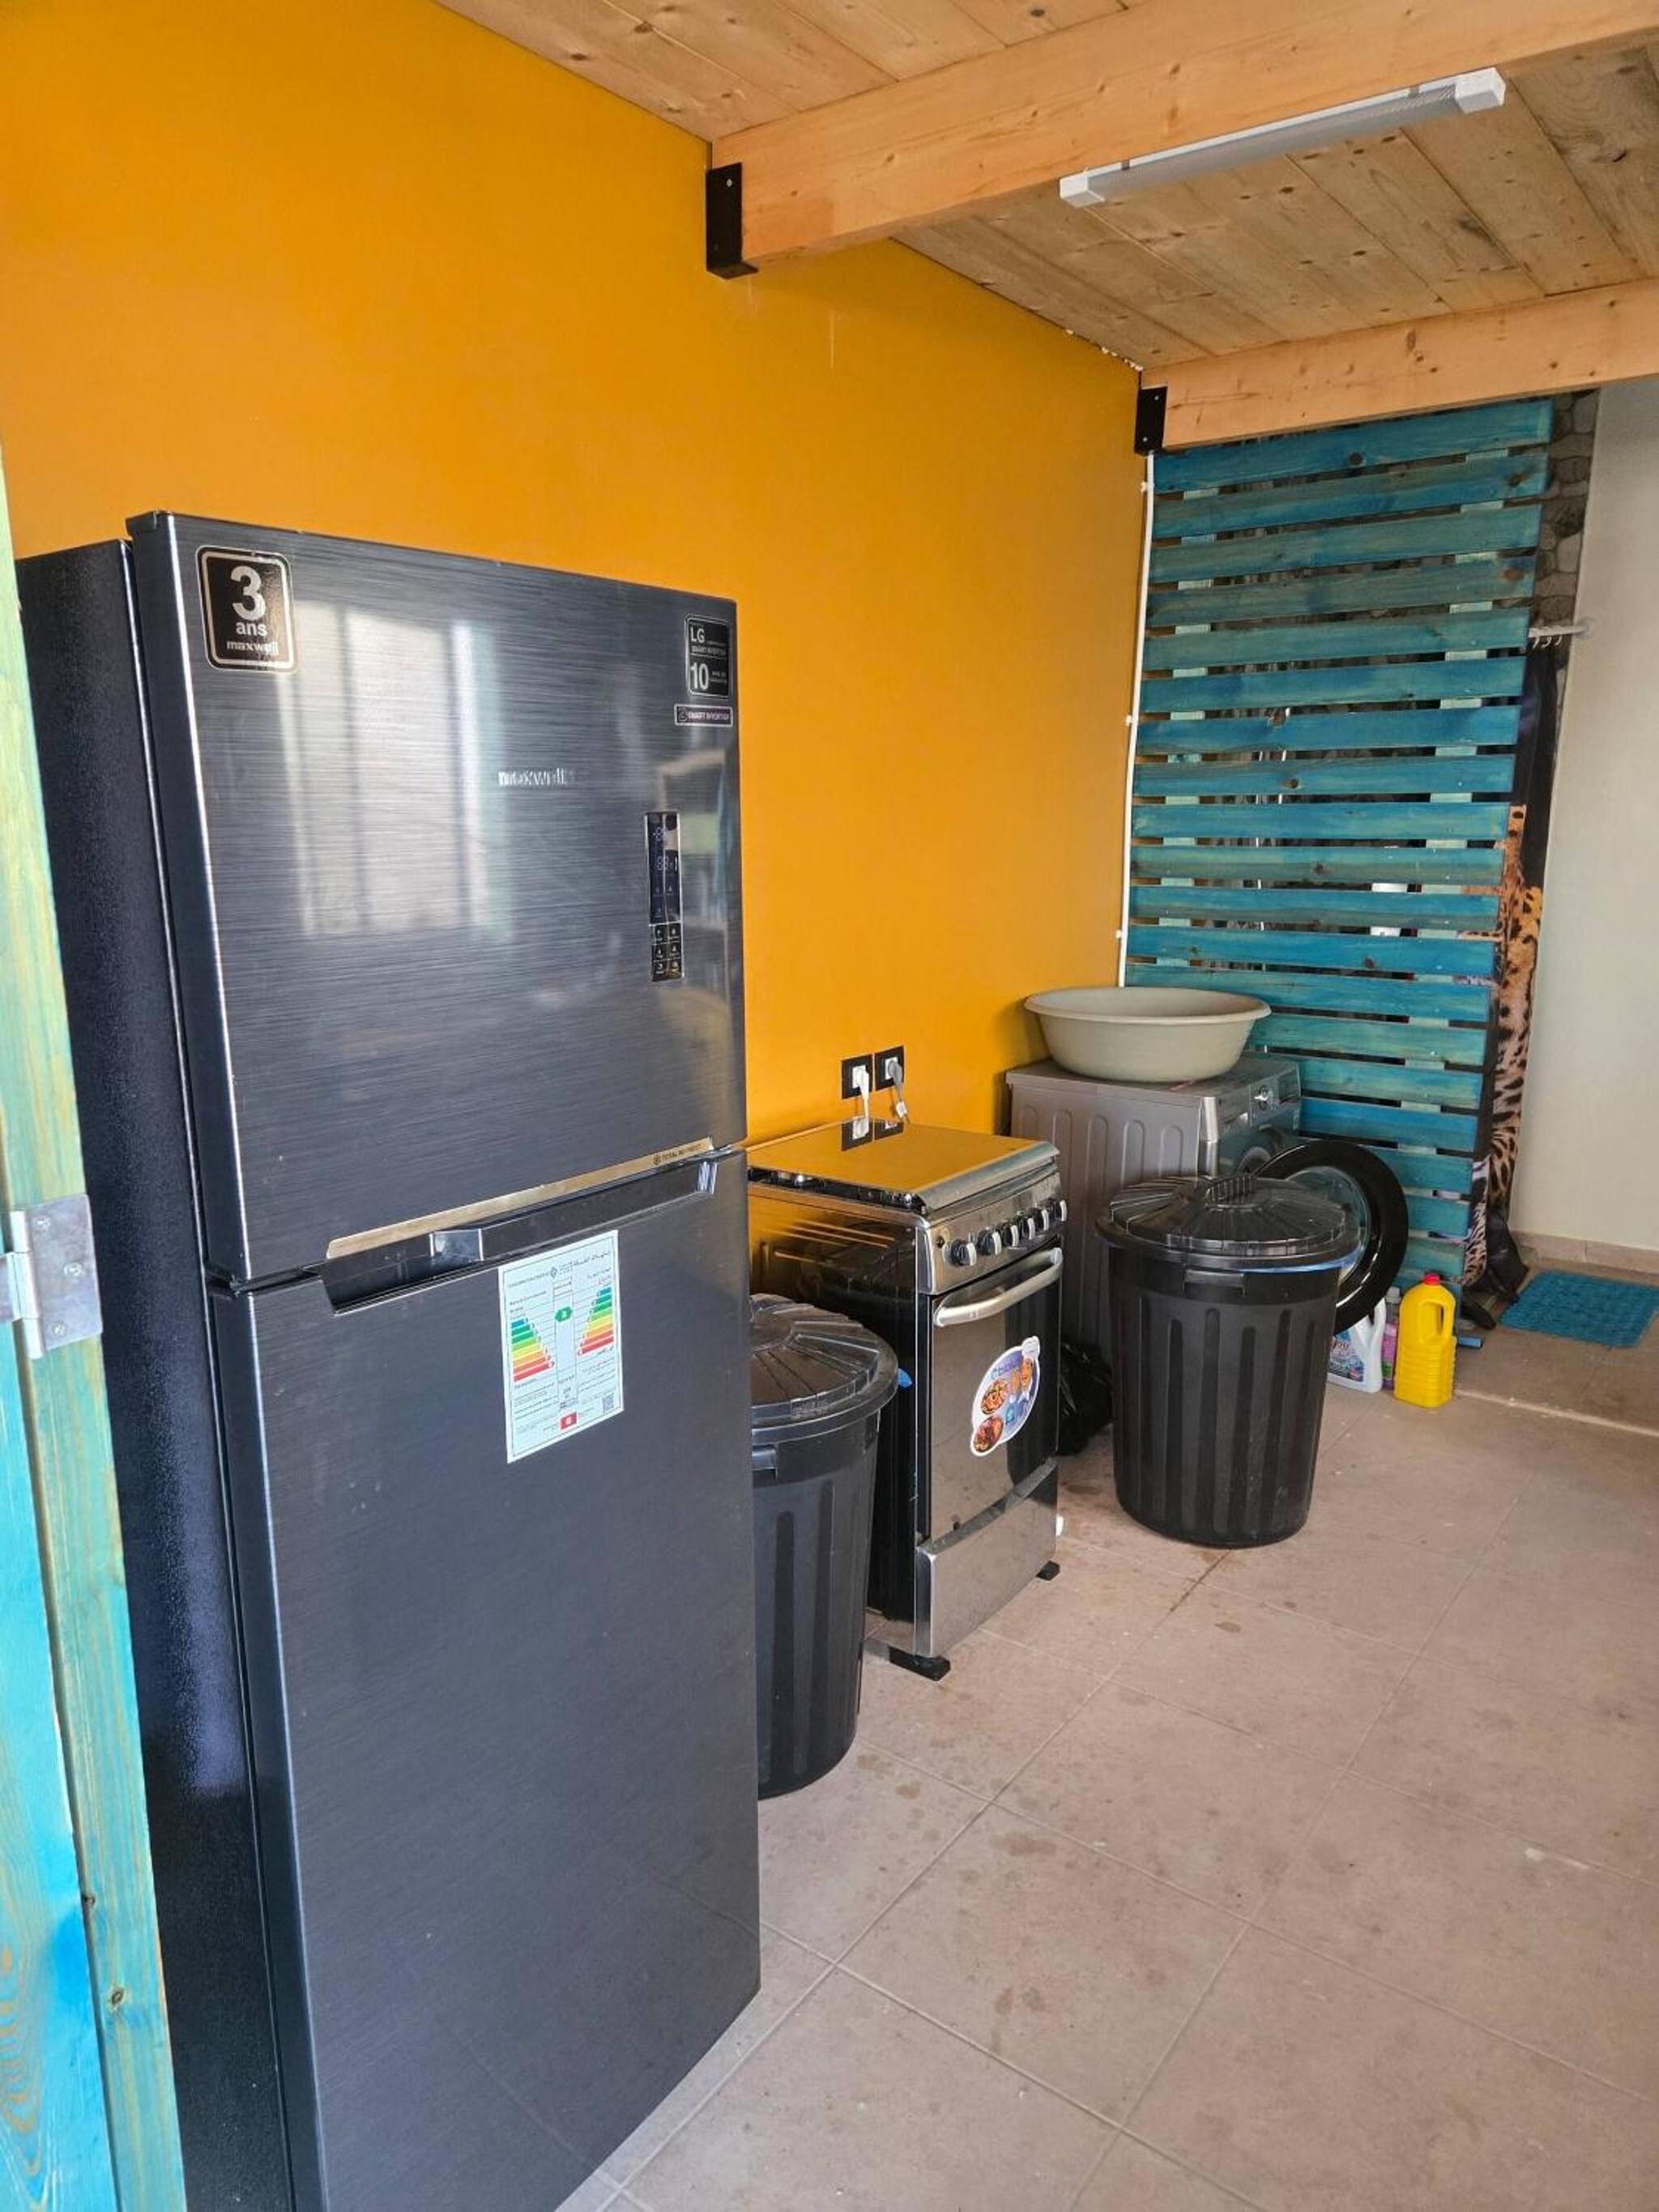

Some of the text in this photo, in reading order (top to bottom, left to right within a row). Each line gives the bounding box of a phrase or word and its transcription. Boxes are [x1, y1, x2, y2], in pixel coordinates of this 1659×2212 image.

[230, 565, 266, 620] 3
[235, 621, 268, 637] ans
[690, 626, 705, 644] LG
[689, 662, 709, 690] 10
